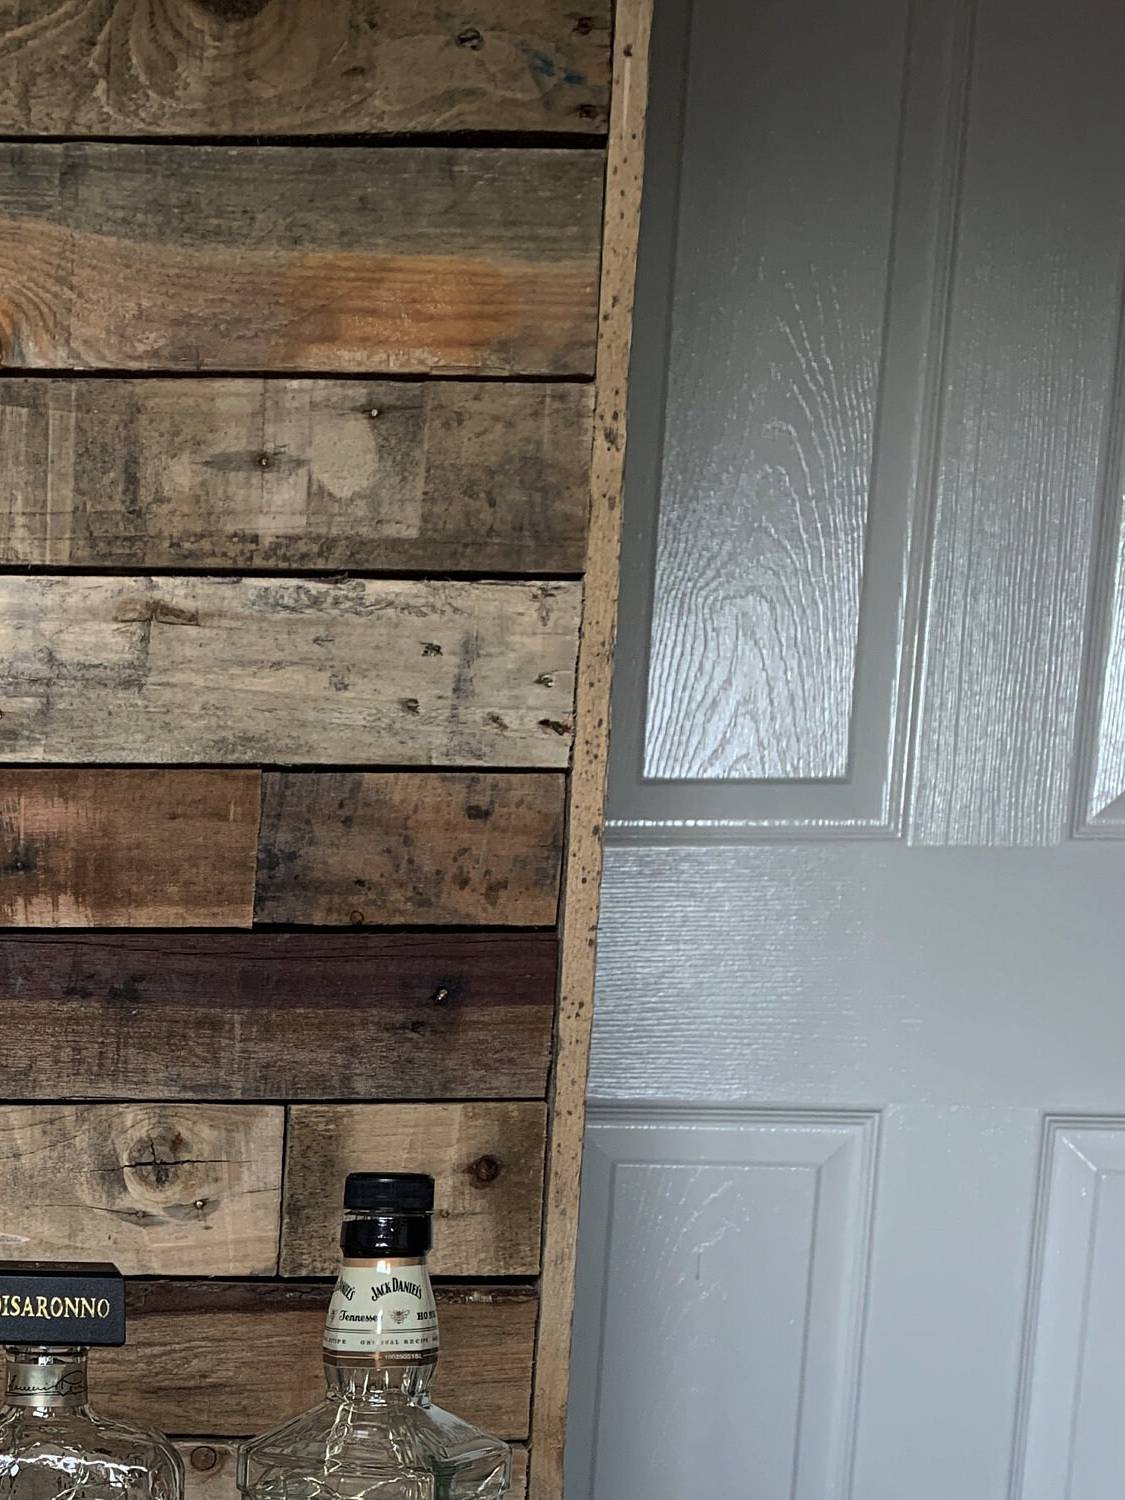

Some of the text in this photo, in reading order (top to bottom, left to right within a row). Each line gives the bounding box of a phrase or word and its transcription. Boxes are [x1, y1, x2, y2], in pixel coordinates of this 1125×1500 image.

[371, 1277, 422, 1301] JACK DANIEL'S
[339, 1310, 382, 1322] Tennesse
